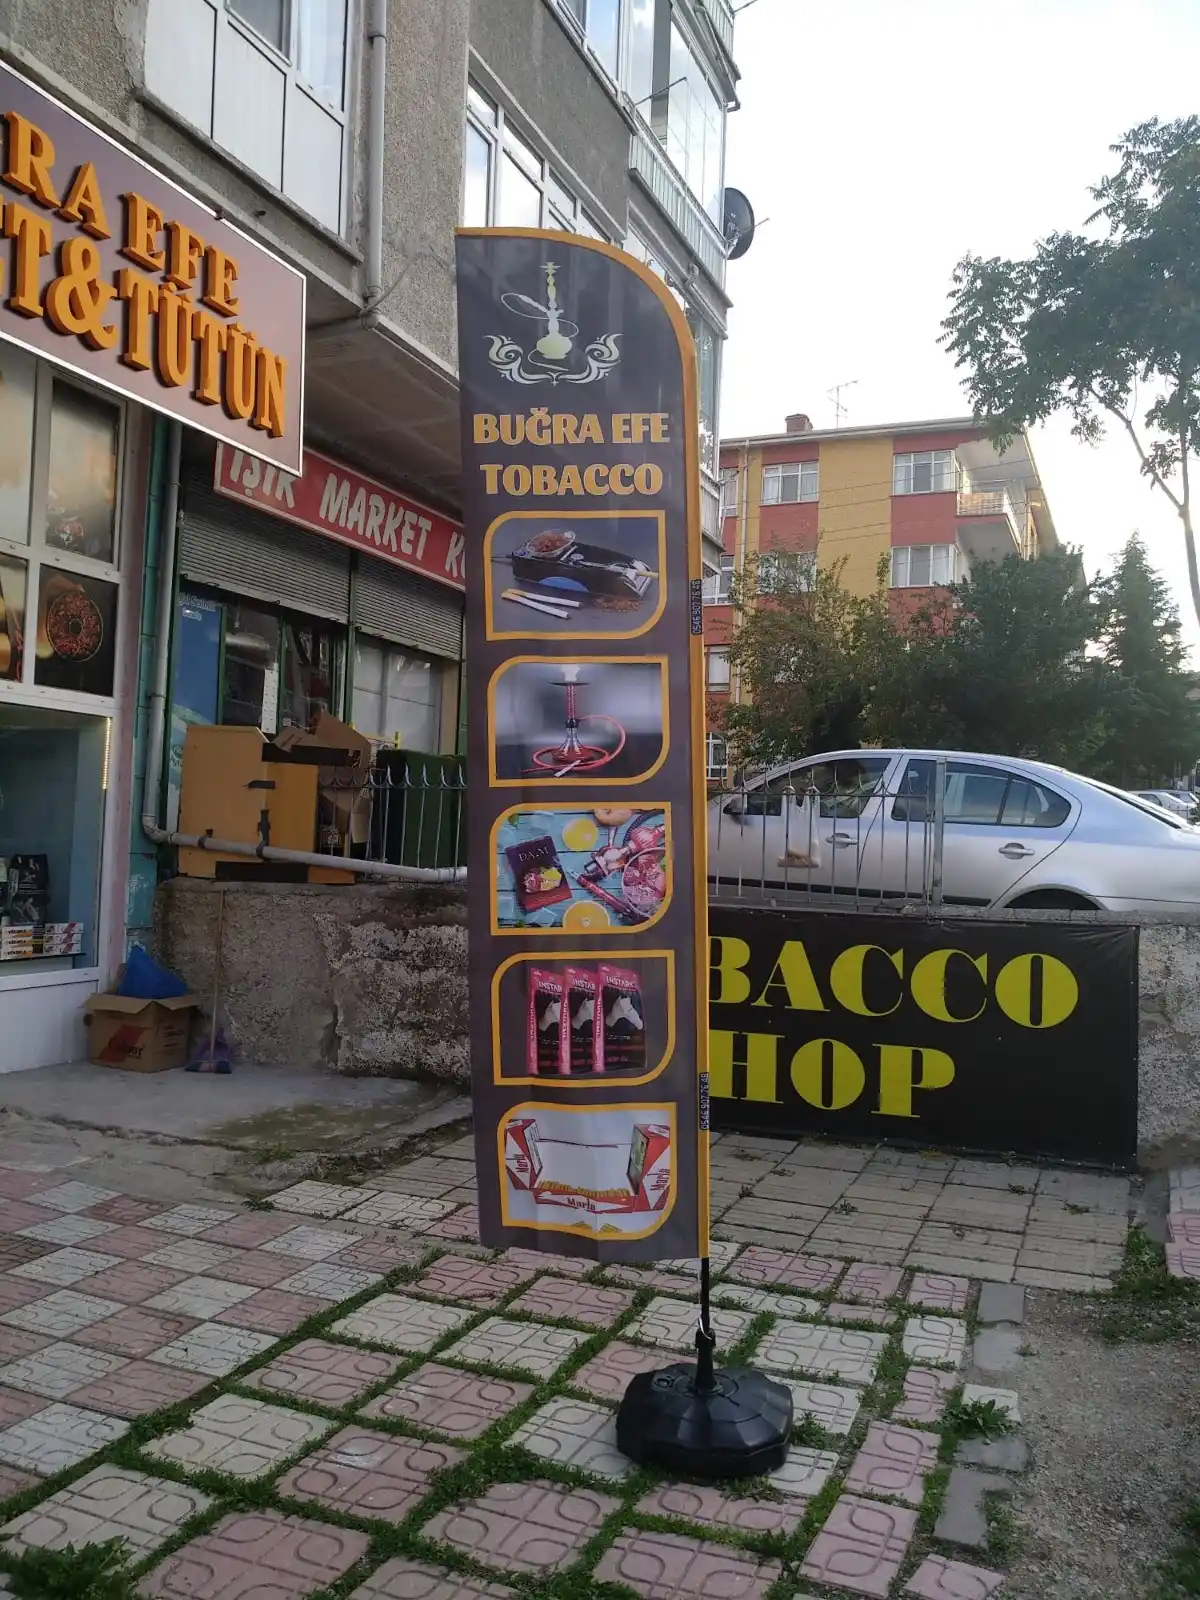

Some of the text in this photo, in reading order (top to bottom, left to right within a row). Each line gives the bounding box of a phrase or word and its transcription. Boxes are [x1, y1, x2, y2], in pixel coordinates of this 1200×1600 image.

[0, 111, 239, 317] RA EFE
[0, 197, 286, 438] T&TÜTÜN
[472, 407, 671, 446] BUĞRA EFE
[479, 463, 663, 496] TOBACCO
[318, 472, 432, 561] MARKET
[445, 531, 466, 579] K
